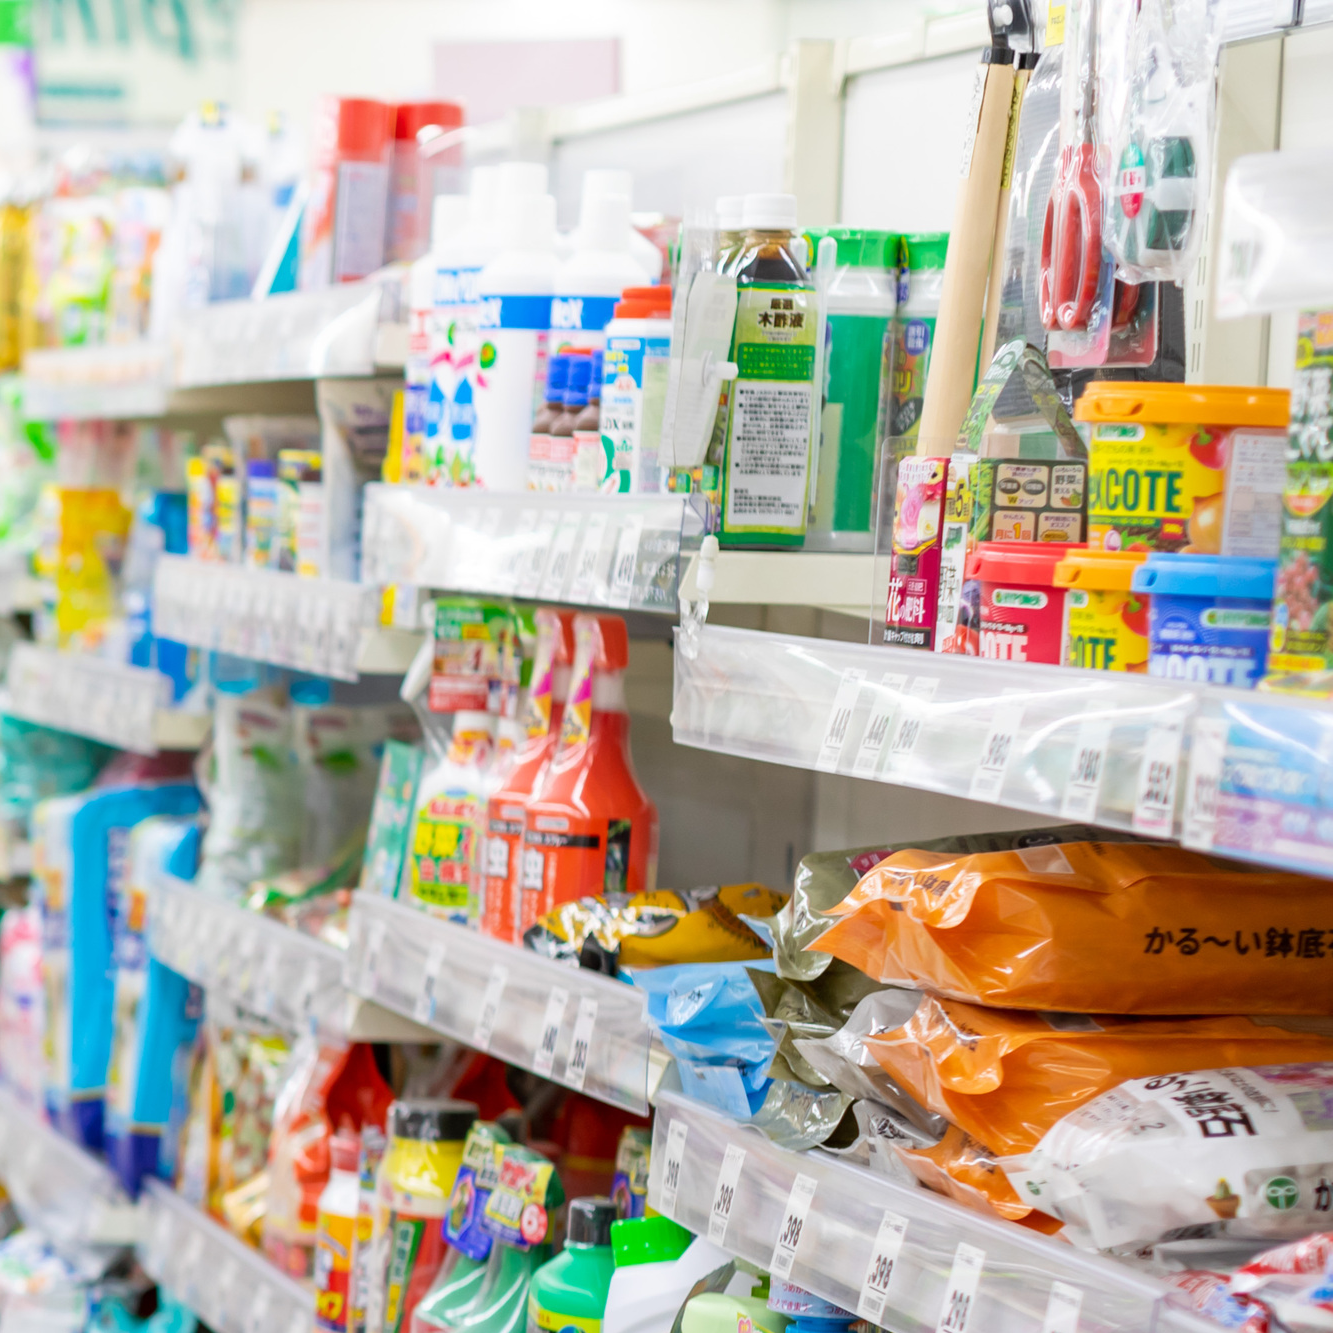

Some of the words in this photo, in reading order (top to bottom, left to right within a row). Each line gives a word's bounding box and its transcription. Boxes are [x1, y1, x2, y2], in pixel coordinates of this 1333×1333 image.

[757, 311, 805, 329] 木酢液
[783, 1213, 804, 1248] 398
[870, 1254, 893, 1291] 398
